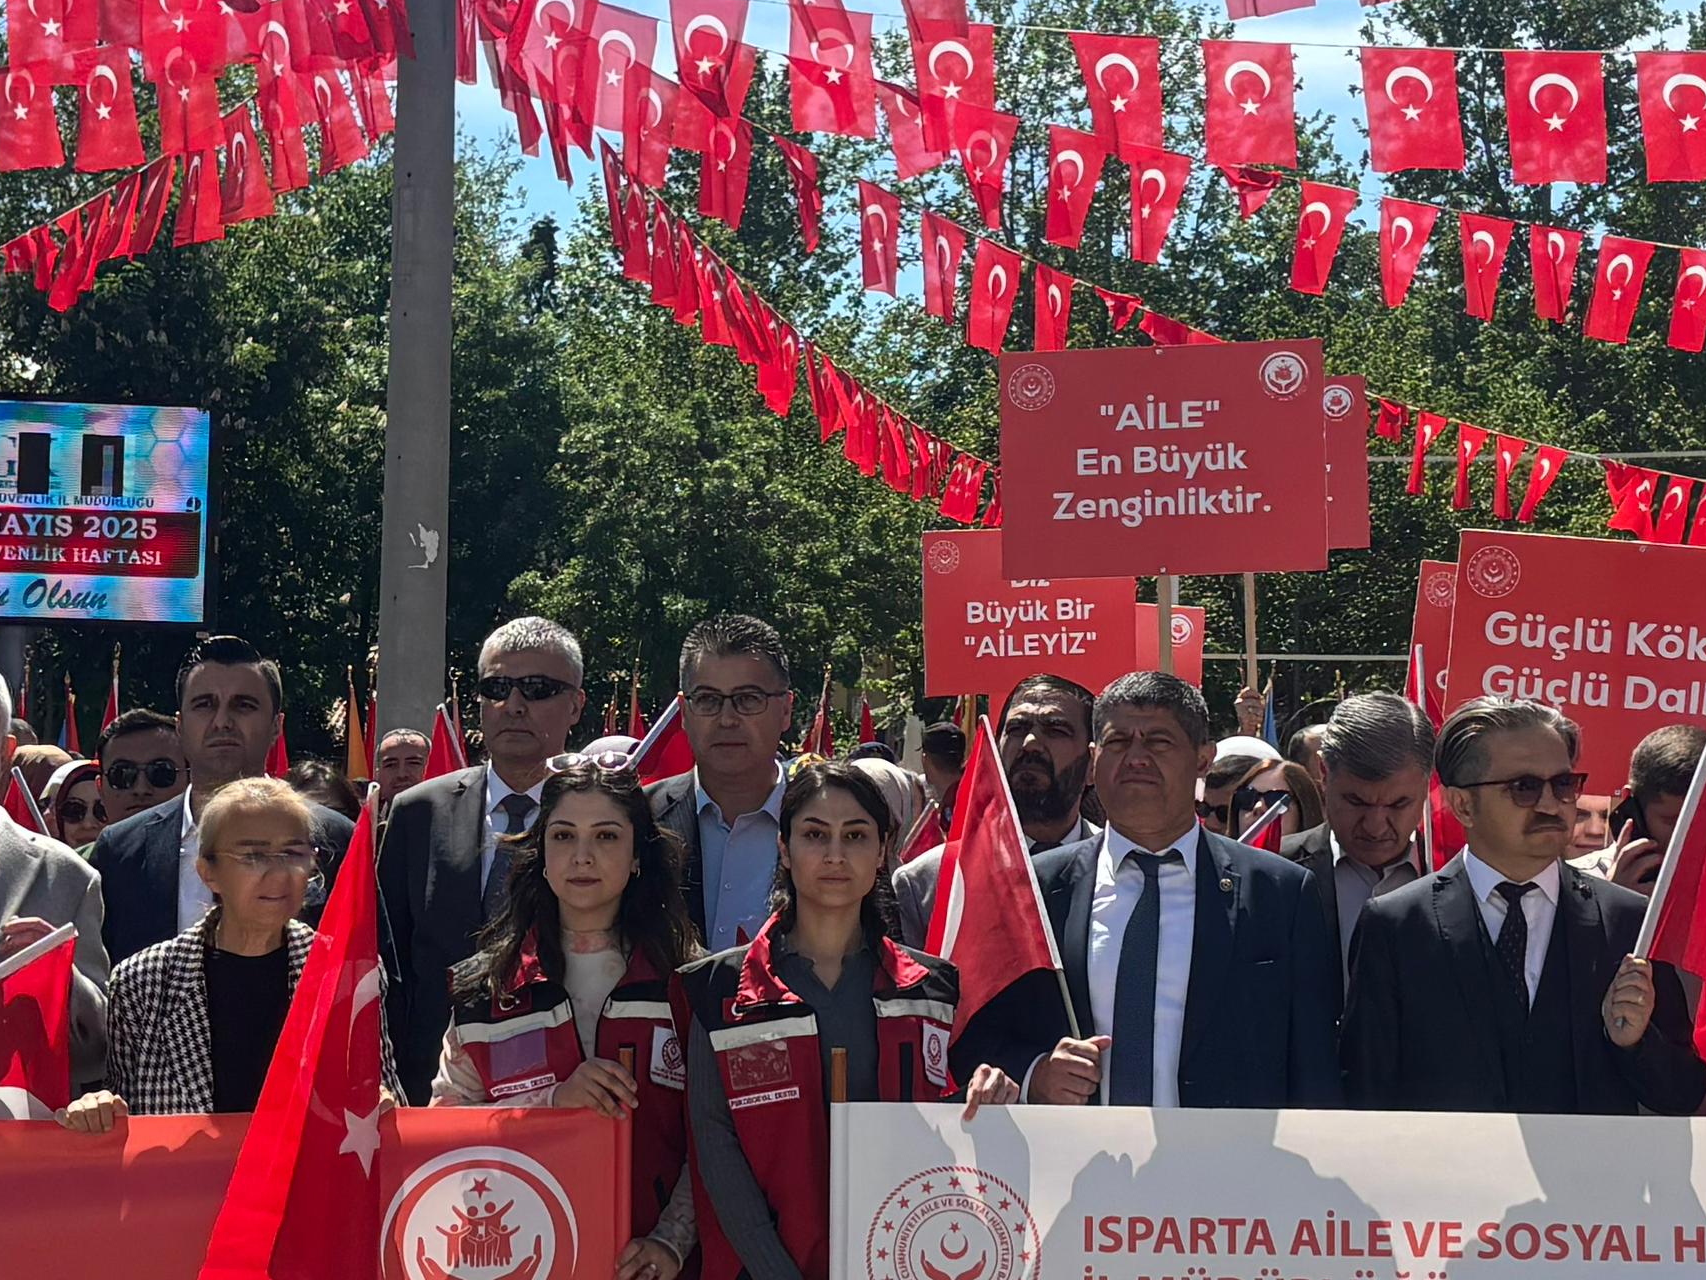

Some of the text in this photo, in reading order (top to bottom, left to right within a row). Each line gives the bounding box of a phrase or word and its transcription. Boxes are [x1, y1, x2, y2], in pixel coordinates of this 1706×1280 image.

[1100, 394, 1220, 432] "AİLE"
[1077, 442, 1248, 480] En Büyük
[1053, 486, 1272, 528] Zenginliktir.
[83, 516, 157, 540] 2025
[73, 547, 162, 566] HAFTASI
[22, 579, 108, 610] Olsun
[967, 599, 1095, 627] Büyük Bir
[964, 628, 1097, 658] "AİLEYİZ"
[1485, 611, 1612, 661] Güçlü
[1481, 665, 1610, 710] Güçlü
[942, 1198, 954, 1208] VE
[1084, 1215, 1277, 1255] ISPARTA
[1289, 1210, 1393, 1258] AİLE
[1403, 1221, 1464, 1259] VE
[1477, 1222, 1661, 1263] SOSYAL
